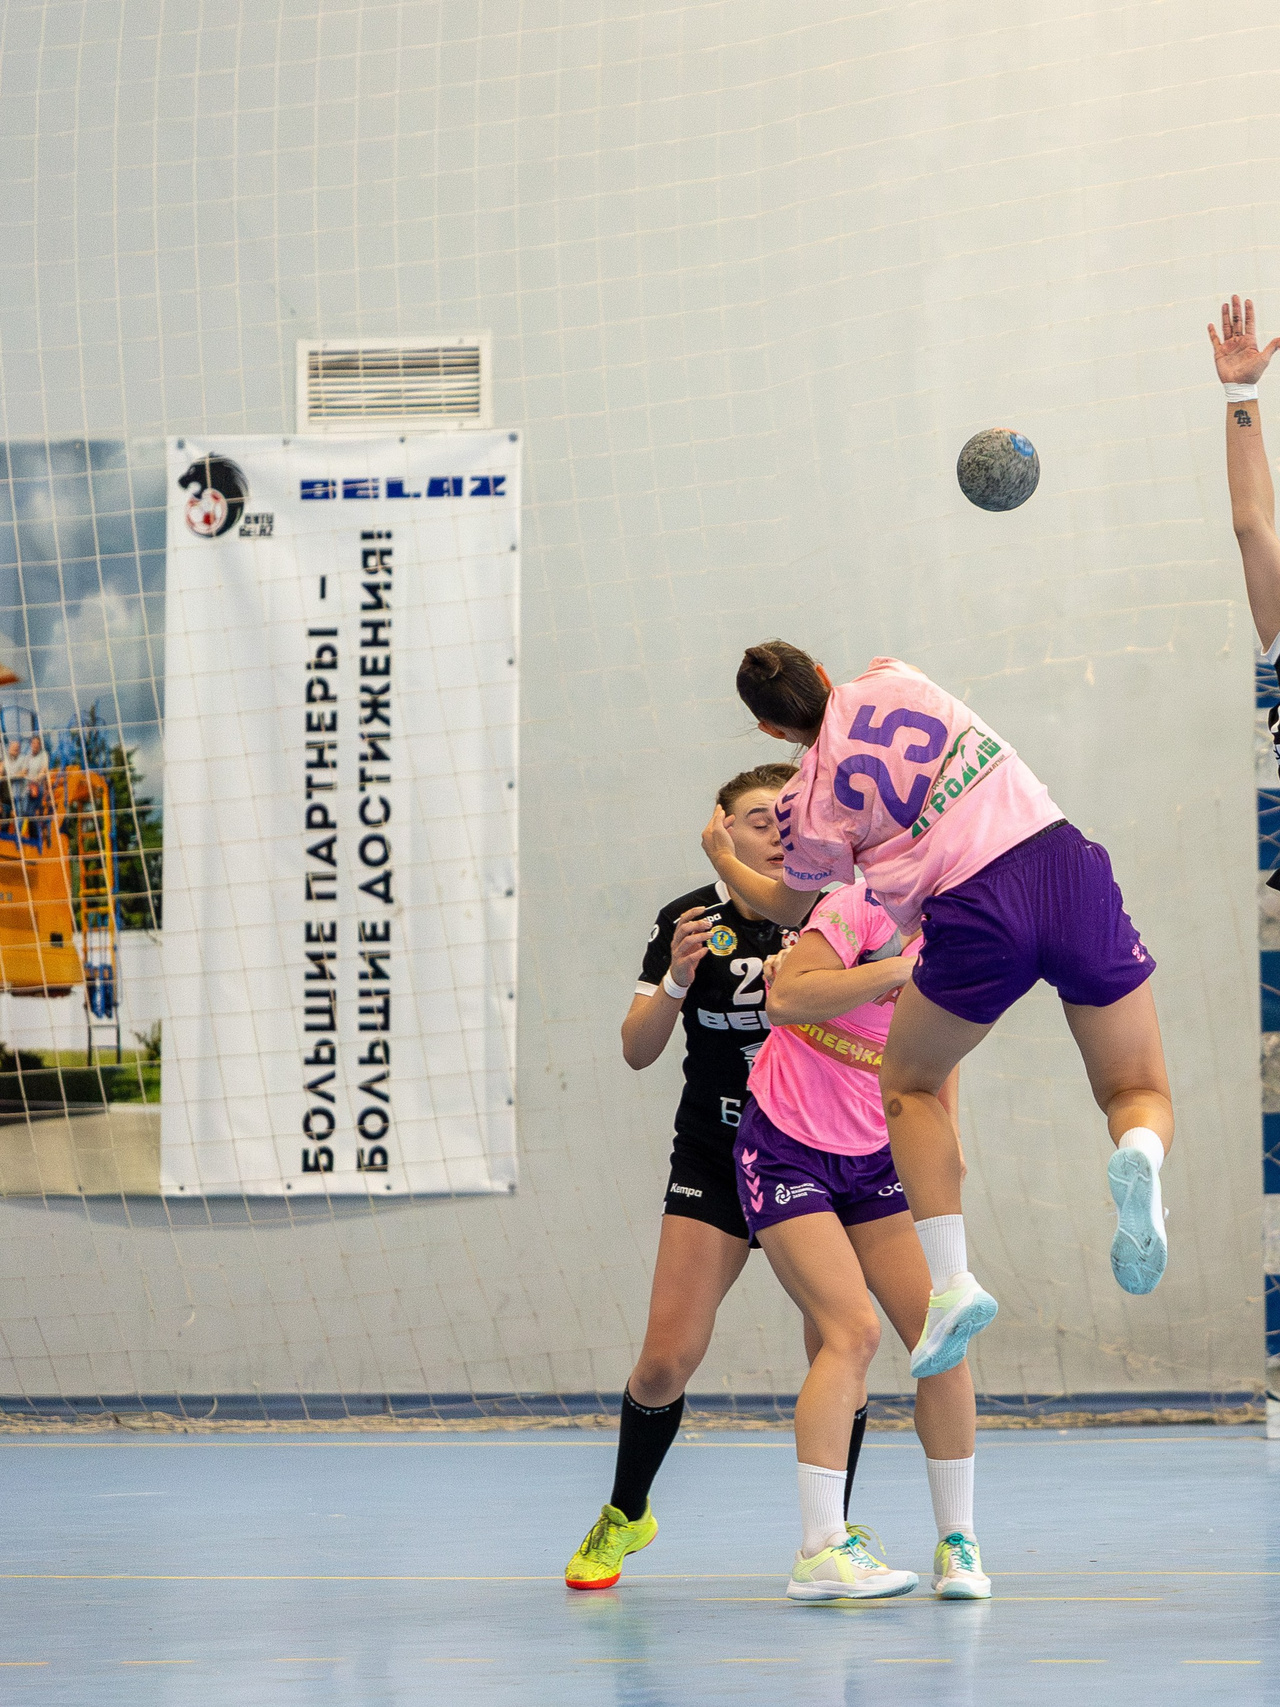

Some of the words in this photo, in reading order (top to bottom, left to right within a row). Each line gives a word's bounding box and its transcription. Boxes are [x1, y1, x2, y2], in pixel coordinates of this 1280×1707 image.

[300, 475, 506, 500] BELAZ
[304, 627, 339, 901] ПАРТНЕРЫ
[358, 530, 394, 904] ДОСТИЖЕНИЯ!
[834, 705, 948, 829] 25
[302, 920, 337, 1172] БОЛЬШИЕ
[356, 920, 390, 1172] БОЛЬШИЕ
[670, 1182, 703, 1198] Kempa
